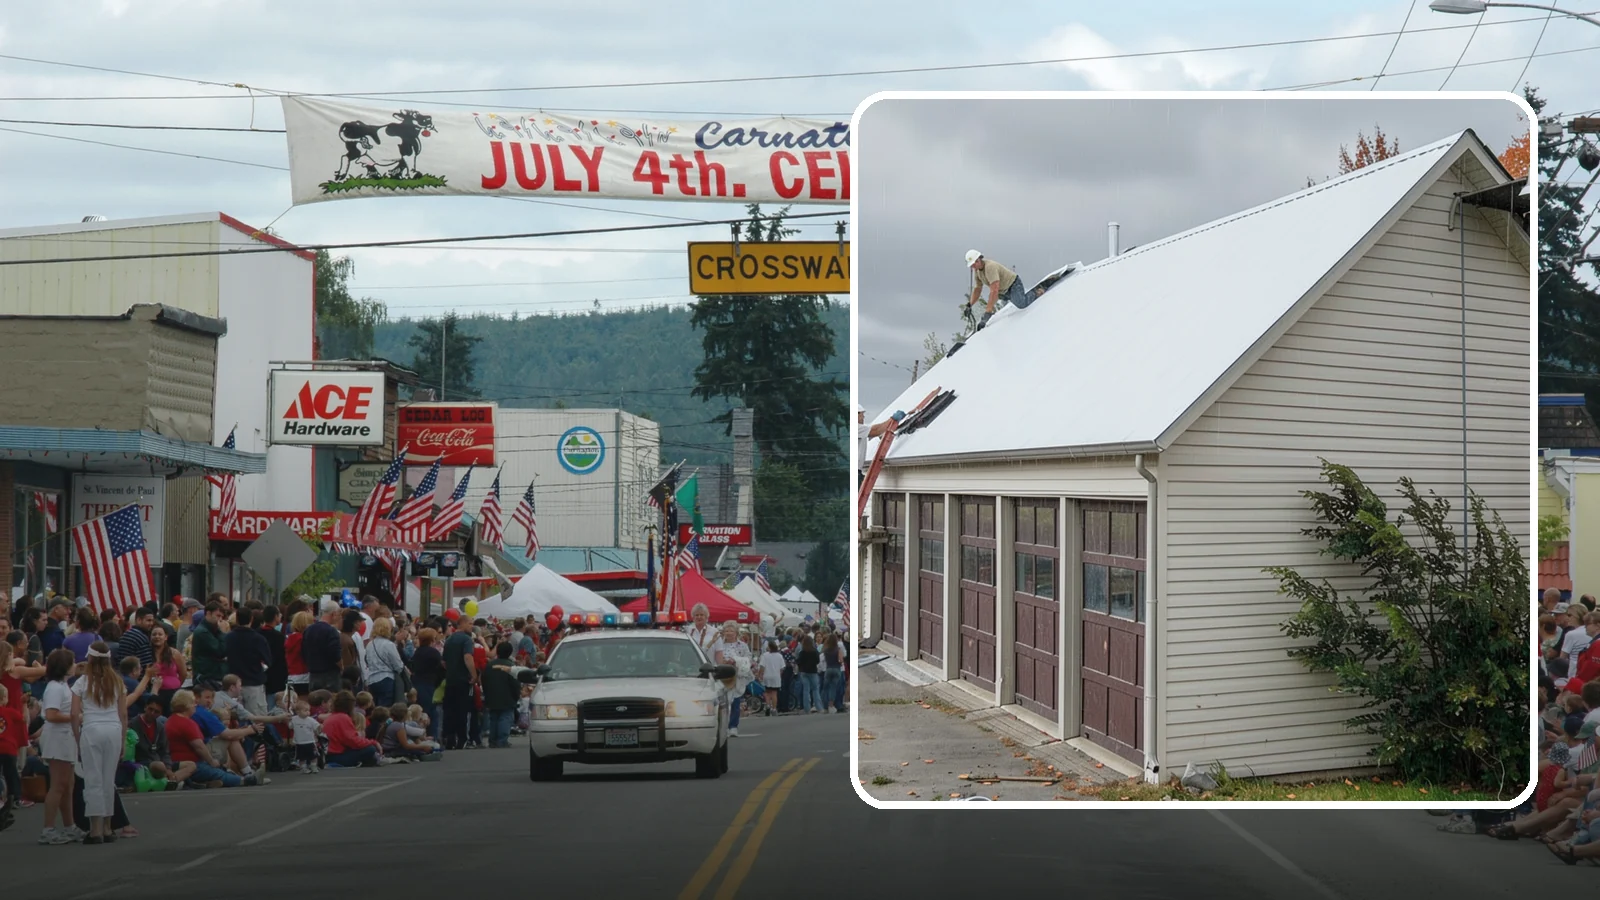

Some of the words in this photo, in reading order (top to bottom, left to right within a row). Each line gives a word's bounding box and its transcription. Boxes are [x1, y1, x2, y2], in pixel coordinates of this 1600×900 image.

[695, 121, 850, 150] Carnat
[481, 141, 605, 193] JULY
[632, 149, 746, 198] 4th.
[697, 254, 850, 280] CROSSWA
[282, 380, 373, 420] ACE
[405, 409, 453, 422] CEDAR
[461, 409, 485, 422] LOG
[283, 421, 370, 436] Hardware
[416, 428, 477, 447] Coca-Cola
[353, 467, 386, 481] Simpl
[83, 485, 94, 494] St.
[96, 485, 125, 495] Vincent
[126, 486, 136, 495] de
[138, 486, 155, 495] Paul
[688, 526, 741, 535] CRNATION
[700, 535, 730, 544] GLASS
